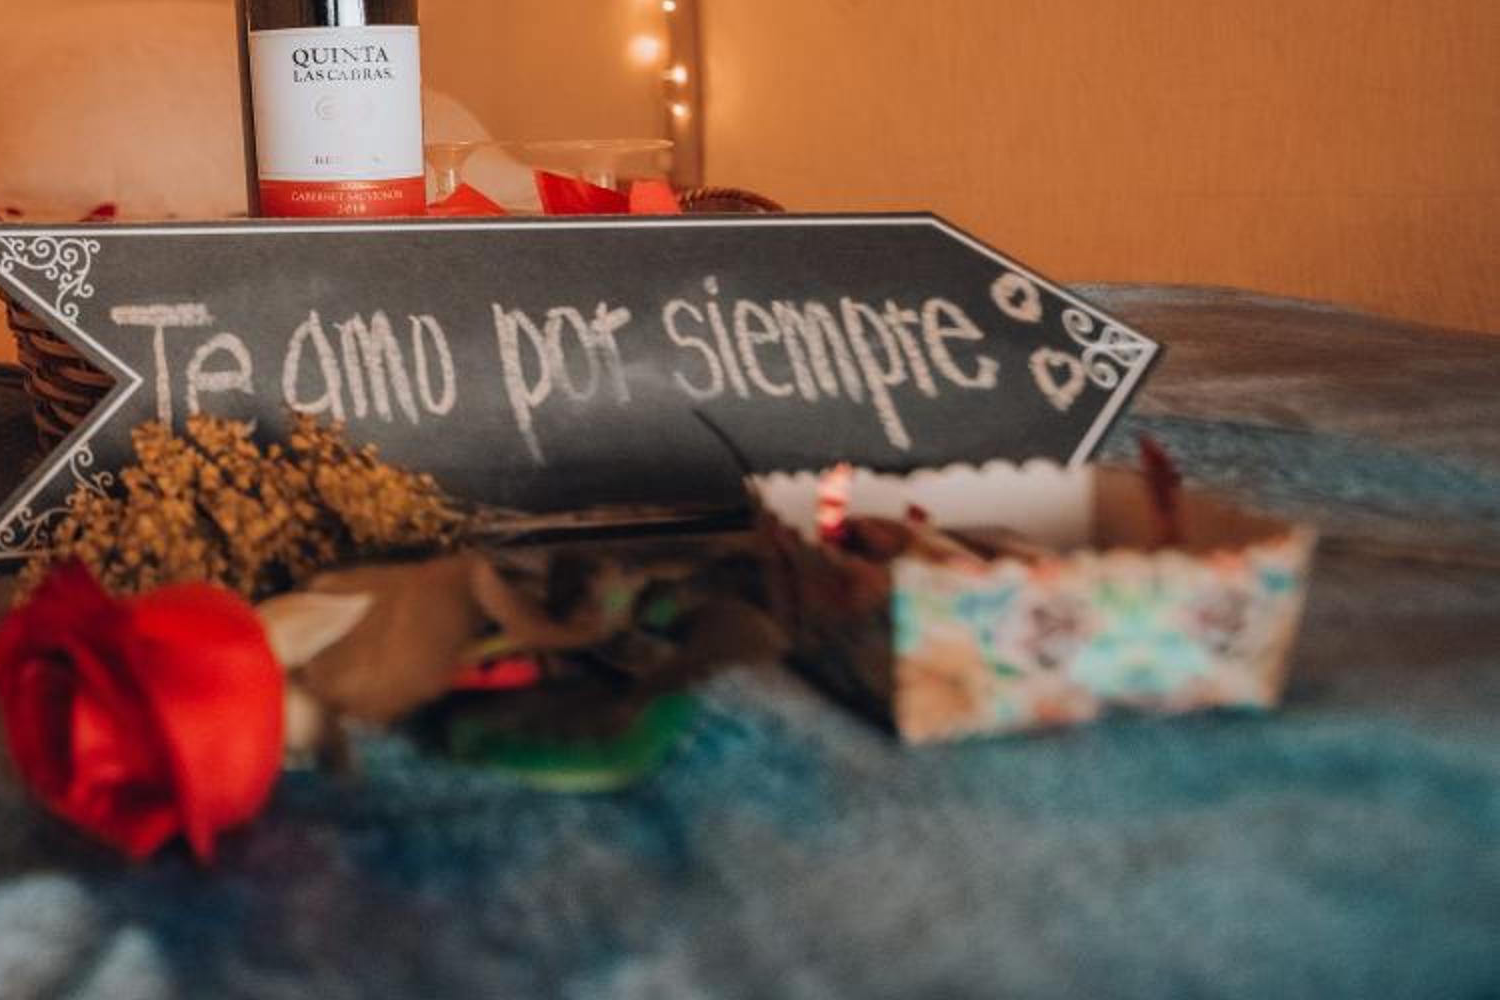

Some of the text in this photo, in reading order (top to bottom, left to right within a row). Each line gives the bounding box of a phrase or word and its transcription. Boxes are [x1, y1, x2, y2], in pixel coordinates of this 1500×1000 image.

[292, 46, 389, 68] QUINTA
[111, 274, 997, 464] Te amo por siempre
